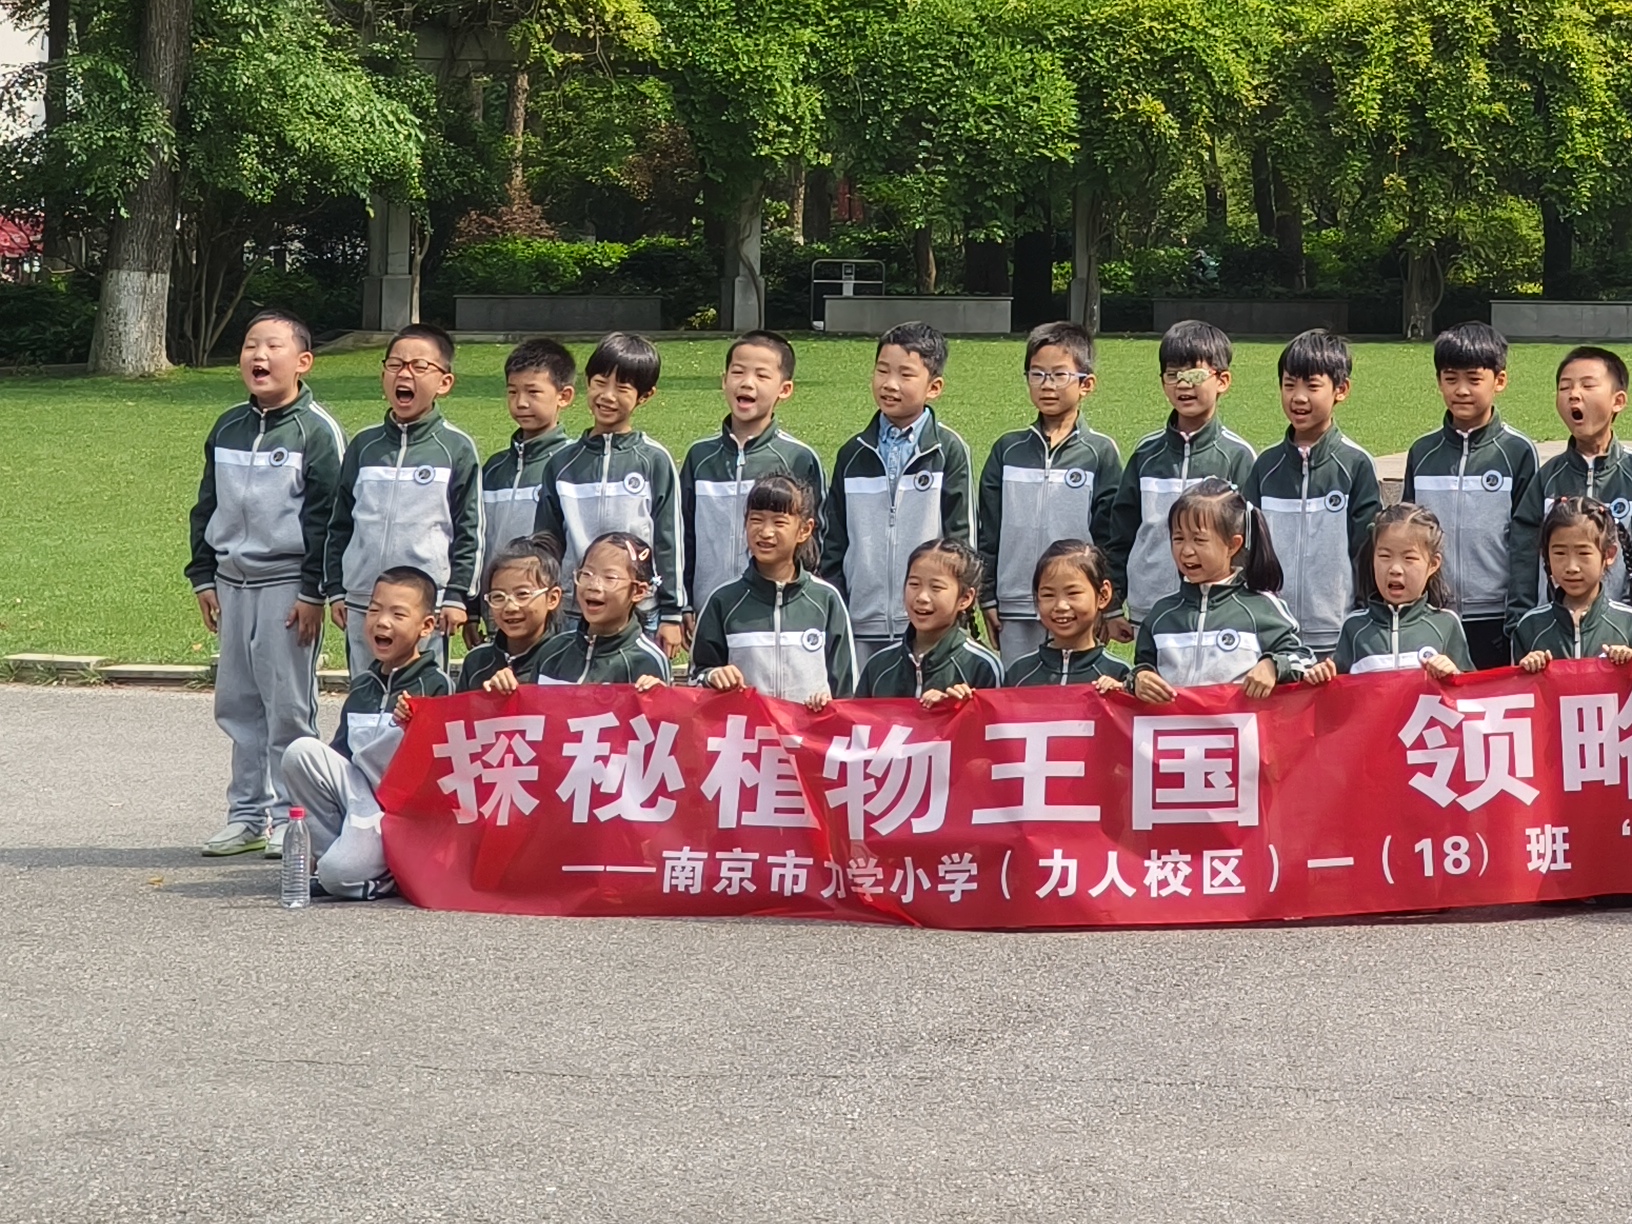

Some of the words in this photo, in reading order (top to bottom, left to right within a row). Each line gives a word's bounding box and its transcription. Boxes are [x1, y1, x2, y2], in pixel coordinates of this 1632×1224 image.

[432, 710, 1260, 839] 探秘植物王国
